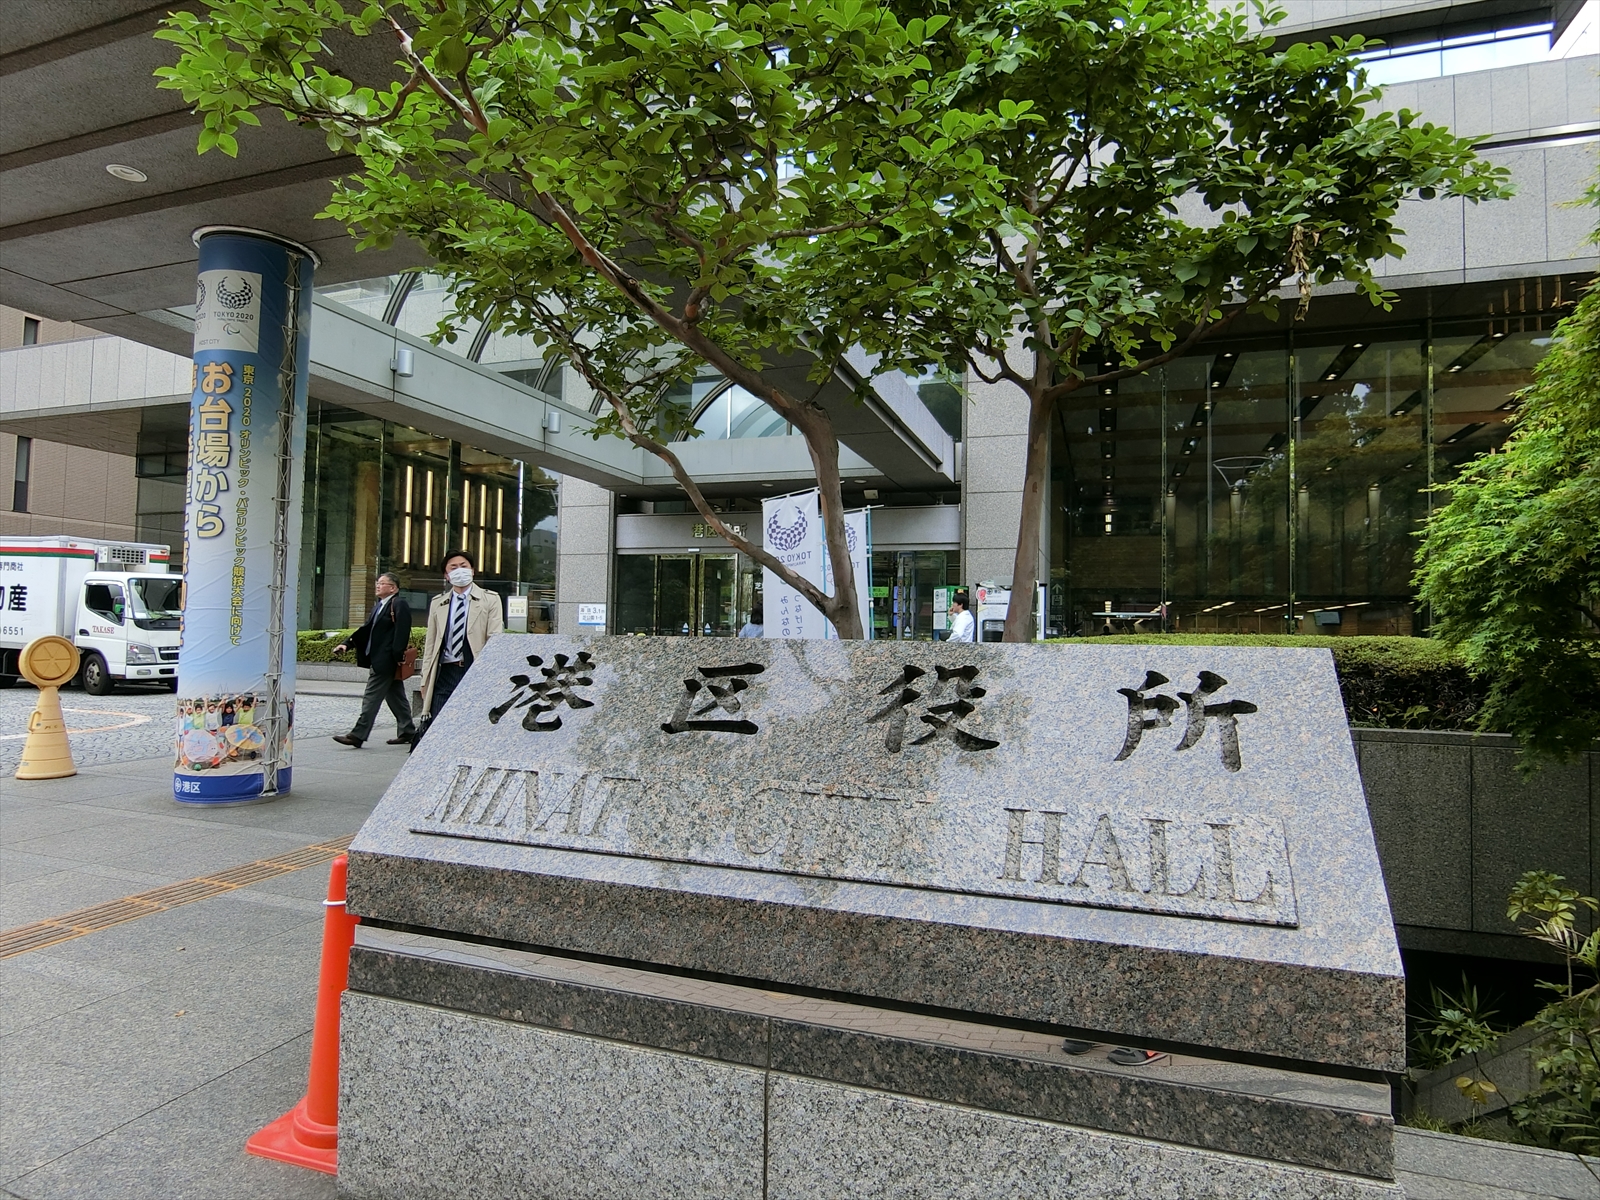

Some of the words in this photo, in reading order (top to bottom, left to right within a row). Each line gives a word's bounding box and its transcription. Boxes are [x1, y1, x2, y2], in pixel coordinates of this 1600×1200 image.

[235, 312, 254, 321] 2020
[195, 361, 234, 539] お台場から
[0, 583, 28, 611] 産
[0, 625, 24, 636] 6551
[92, 625, 115, 634] TAKASE
[182, 781, 201, 793] 港区
[996, 807, 1276, 905] HALL
